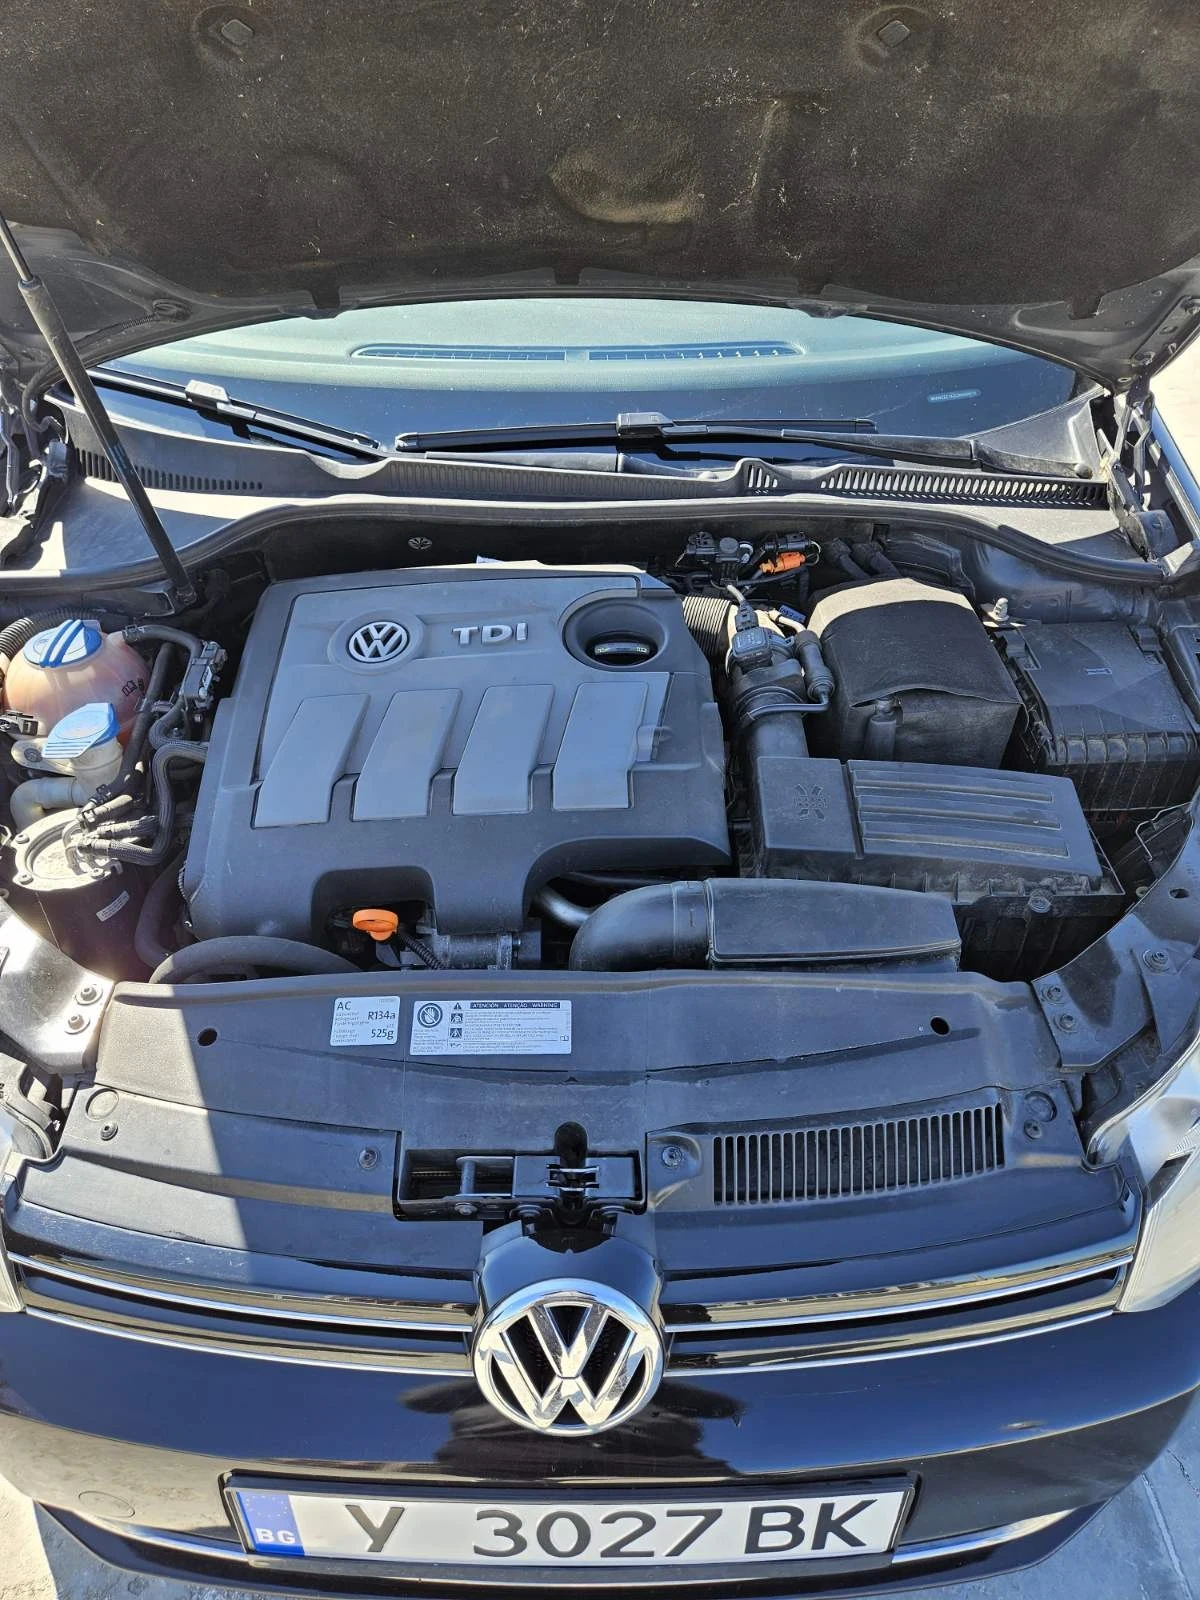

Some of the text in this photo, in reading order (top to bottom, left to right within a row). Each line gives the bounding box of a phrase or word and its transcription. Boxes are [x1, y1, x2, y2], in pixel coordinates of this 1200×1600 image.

[452, 622, 528, 646] TDI
[336, 1001, 352, 1011] AC
[367, 1010, 396, 1021] R134a
[371, 1028, 395, 1041] 525g
[473, 1508, 723, 1558] 3027
[744, 1498, 878, 1554] BK
[256, 1527, 296, 1547] BG
